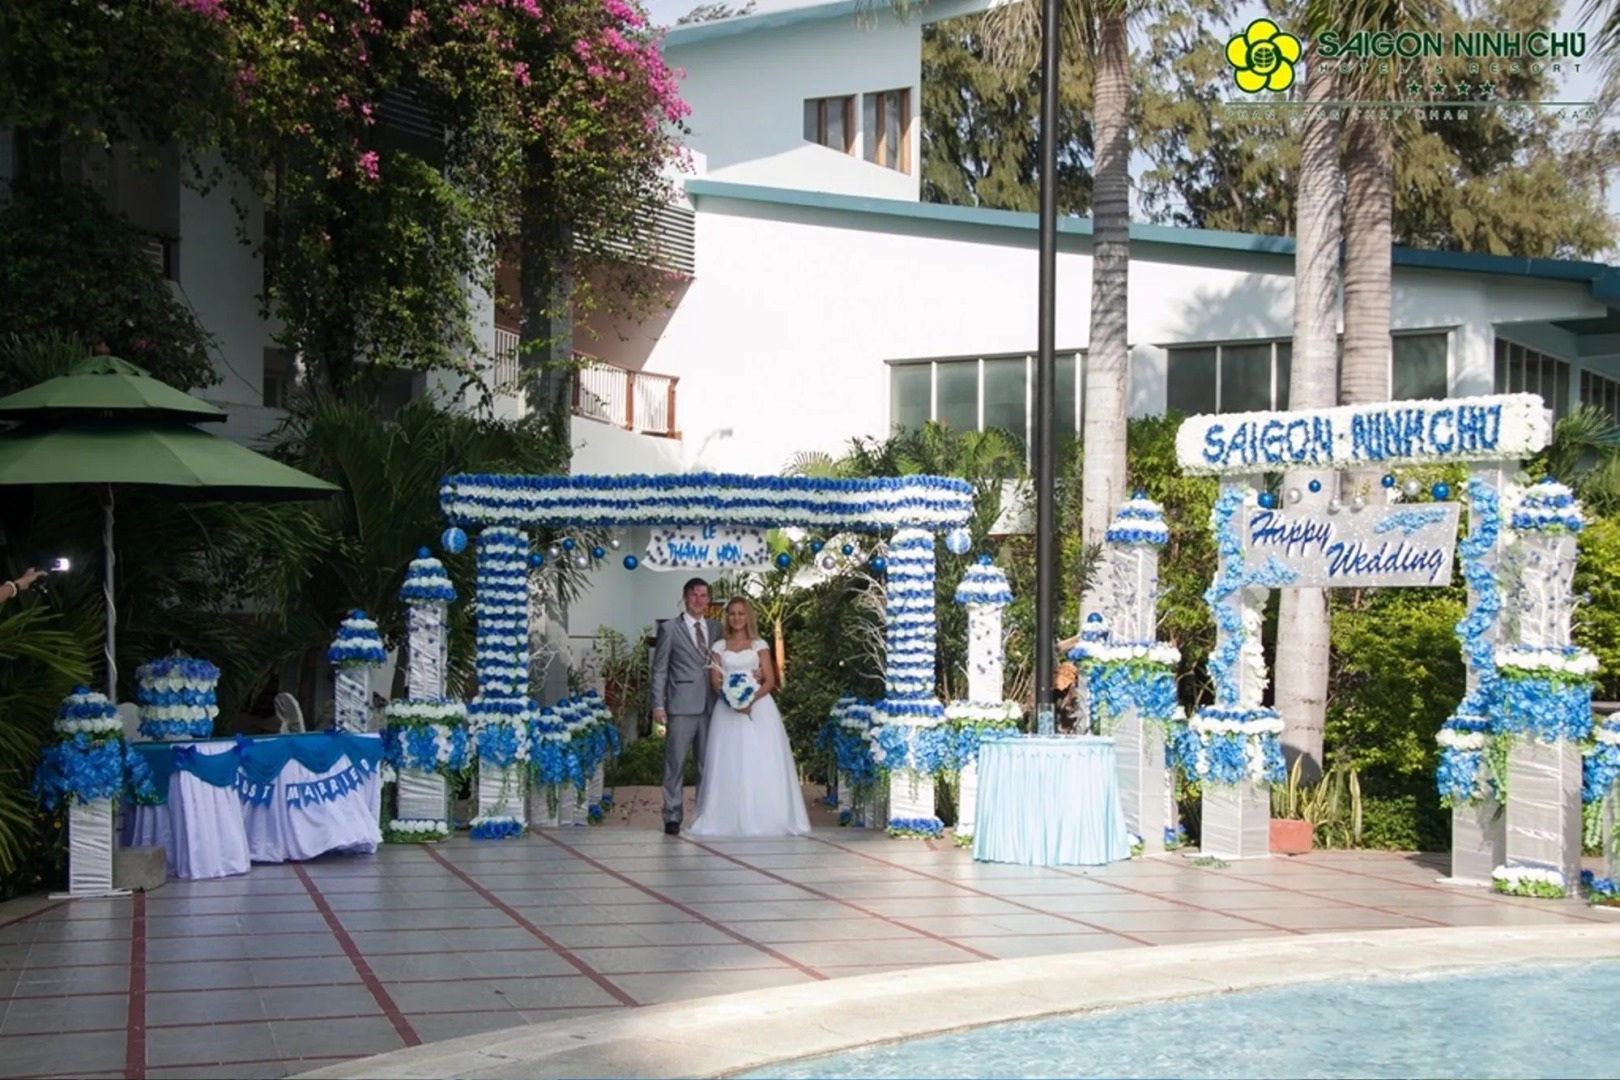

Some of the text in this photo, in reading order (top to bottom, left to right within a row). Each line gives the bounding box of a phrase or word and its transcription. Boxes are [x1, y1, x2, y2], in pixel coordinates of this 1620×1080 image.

[1202, 415, 1333, 466] SAIGON
[1351, 409, 1425, 462] NINH
[1249, 511, 1335, 558] Happy
[1325, 541, 1448, 584] Wedding
[234, 757, 371, 800] JUST MARRIED
